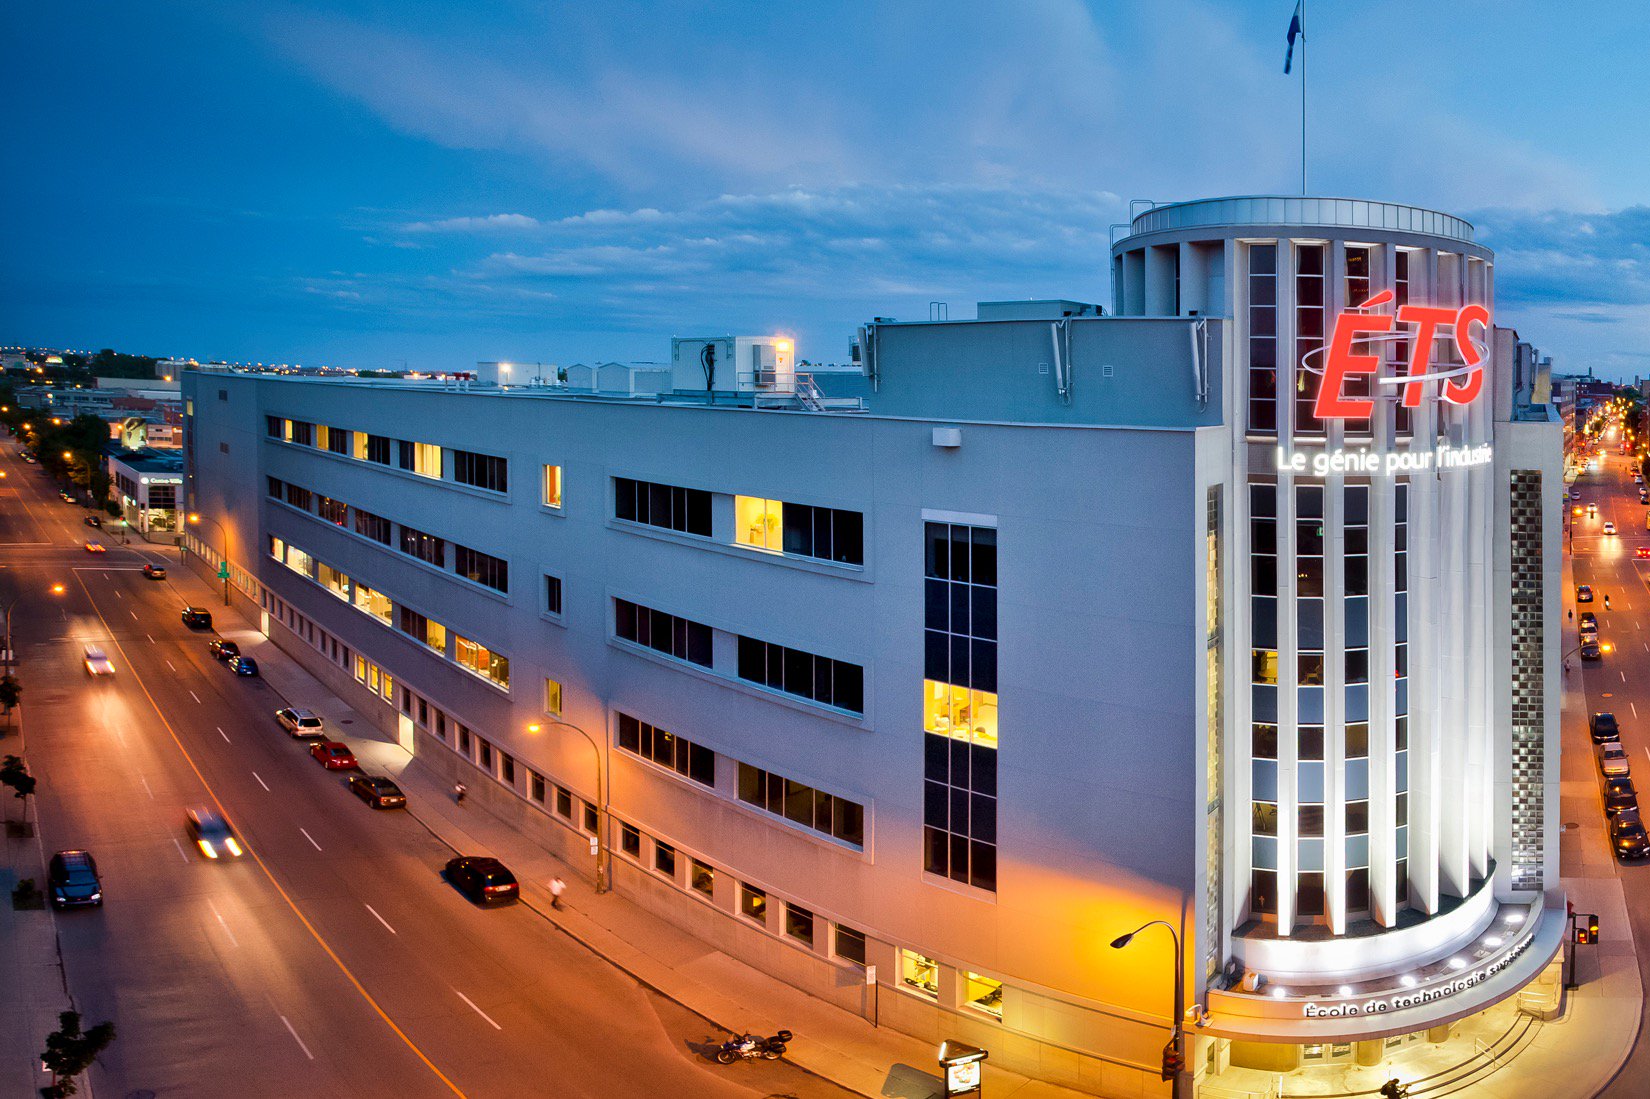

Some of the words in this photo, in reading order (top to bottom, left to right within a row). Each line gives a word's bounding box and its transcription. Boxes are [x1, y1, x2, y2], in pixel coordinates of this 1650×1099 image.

[1313, 289, 1490, 420] ÉTS
[1276, 447, 1306, 472] Le
[1313, 447, 1380, 477] génie
[1386, 452, 1433, 476] pour
[1305, 1003, 1359, 1018] École
[1366, 1001, 1388, 1014] de
[1394, 972, 1487, 1009] technologie
